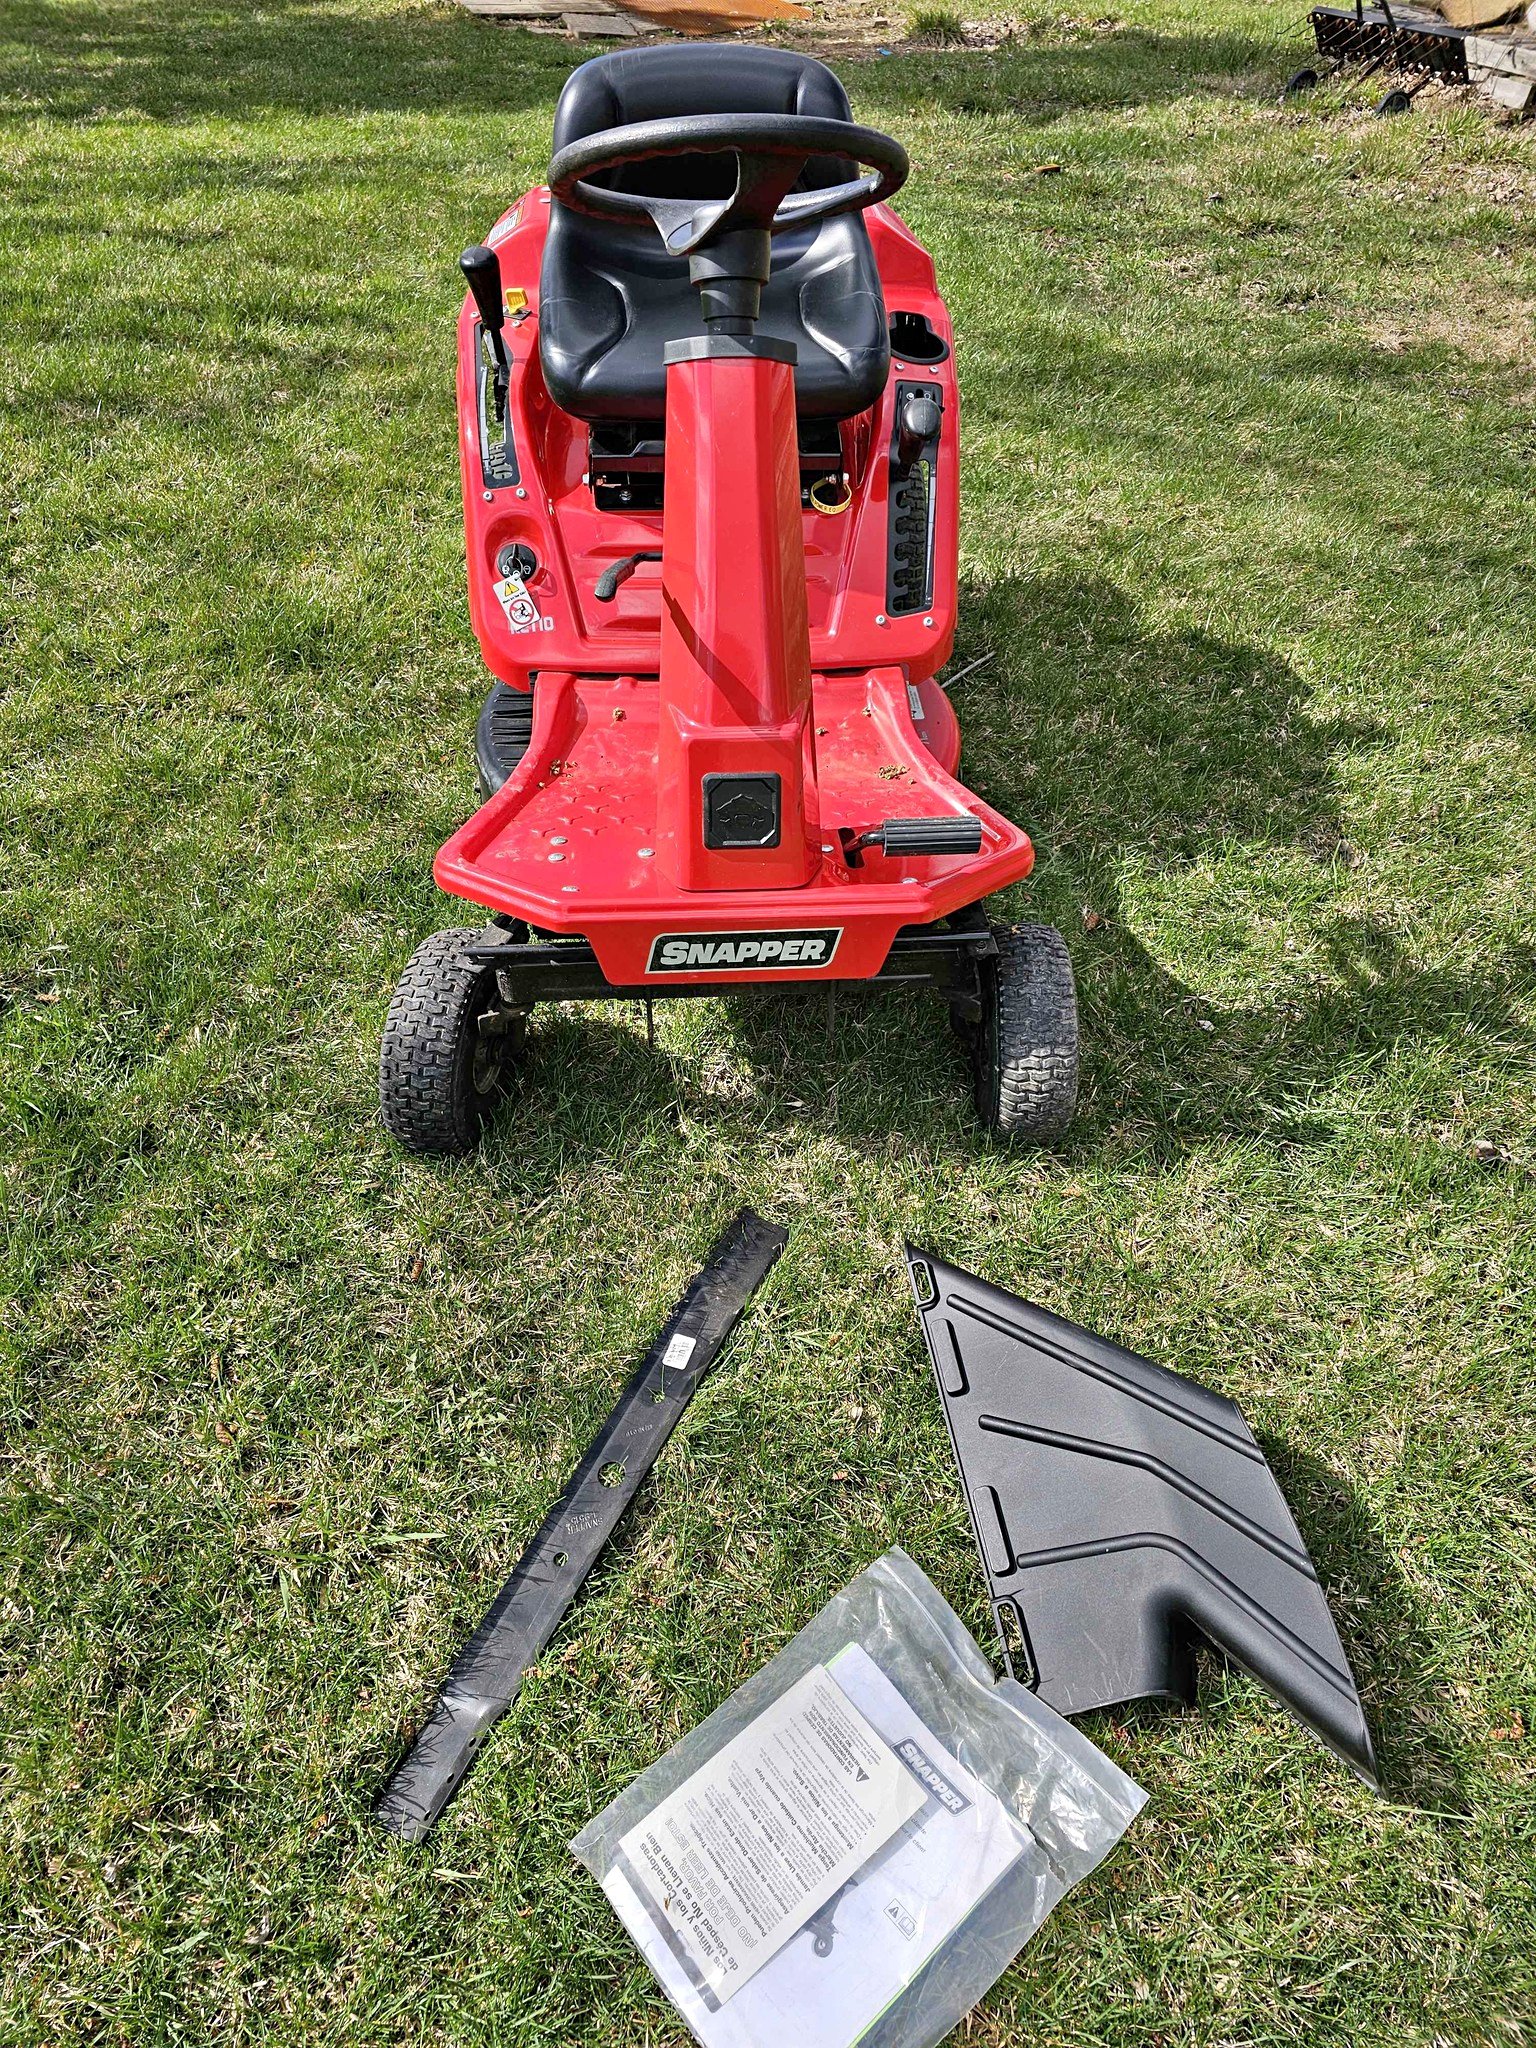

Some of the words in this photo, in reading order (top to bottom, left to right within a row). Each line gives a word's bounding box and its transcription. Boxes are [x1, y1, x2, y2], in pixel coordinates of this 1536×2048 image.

[660, 939, 826, 965] SNAPPER
[753, 1766, 766, 1783] Vaya
[900, 1743, 963, 1812] SNAPPER
[763, 1780, 781, 1802] cuando
[807, 1789, 822, 1808] Niños
[713, 1806, 723, 1819] sus
[747, 1807, 758, 1821] Dar
[778, 1800, 798, 1826] Cuidado
[819, 1806, 829, 1817] los
[663, 1816, 691, 1851] ESTO!
[720, 1817, 735, 1837] Están
[759, 1824, 774, 1843] Niños
[830, 1820, 854, 1850] Mantenga
[644, 1830, 662, 1855] Bien
[772, 1841, 781, 1853] los
[685, 1847, 710, 1880] LEER
[705, 1846, 729, 1881] Accidentes
[746, 1855, 762, 1875] Saber
[782, 1856, 796, 1873] Lleve
[816, 1852, 832, 1872] Tenga
[817, 1843, 836, 1867] Marcha
[638, 1841, 678, 1900] Cortadoras
[659, 1853, 684, 1888] Llevan
[677, 1856, 708, 1901] FAVOR,
[759, 1873, 768, 1883] de
[680, 1885, 693, 1901] se
[704, 1876, 722, 1898] DE
[794, 1871, 811, 1893] Jamás
[674, 1897, 689, 1917] los
[727, 1879, 752, 1914] Producirse
[685, 1914, 695, 1925] y
[689, 1899, 704, 1919] No
[702, 1896, 725, 1926] POR
[716, 1893, 742, 1928] DEJE
[749, 1912, 768, 1937] Pueden
[691, 1923, 715, 1956] Niños
[699, 1916, 729, 1957] Césped
[736, 1923, 758, 1950] ¡NO
[711, 1953, 729, 1976] Los
[726, 1955, 739, 1972] de
